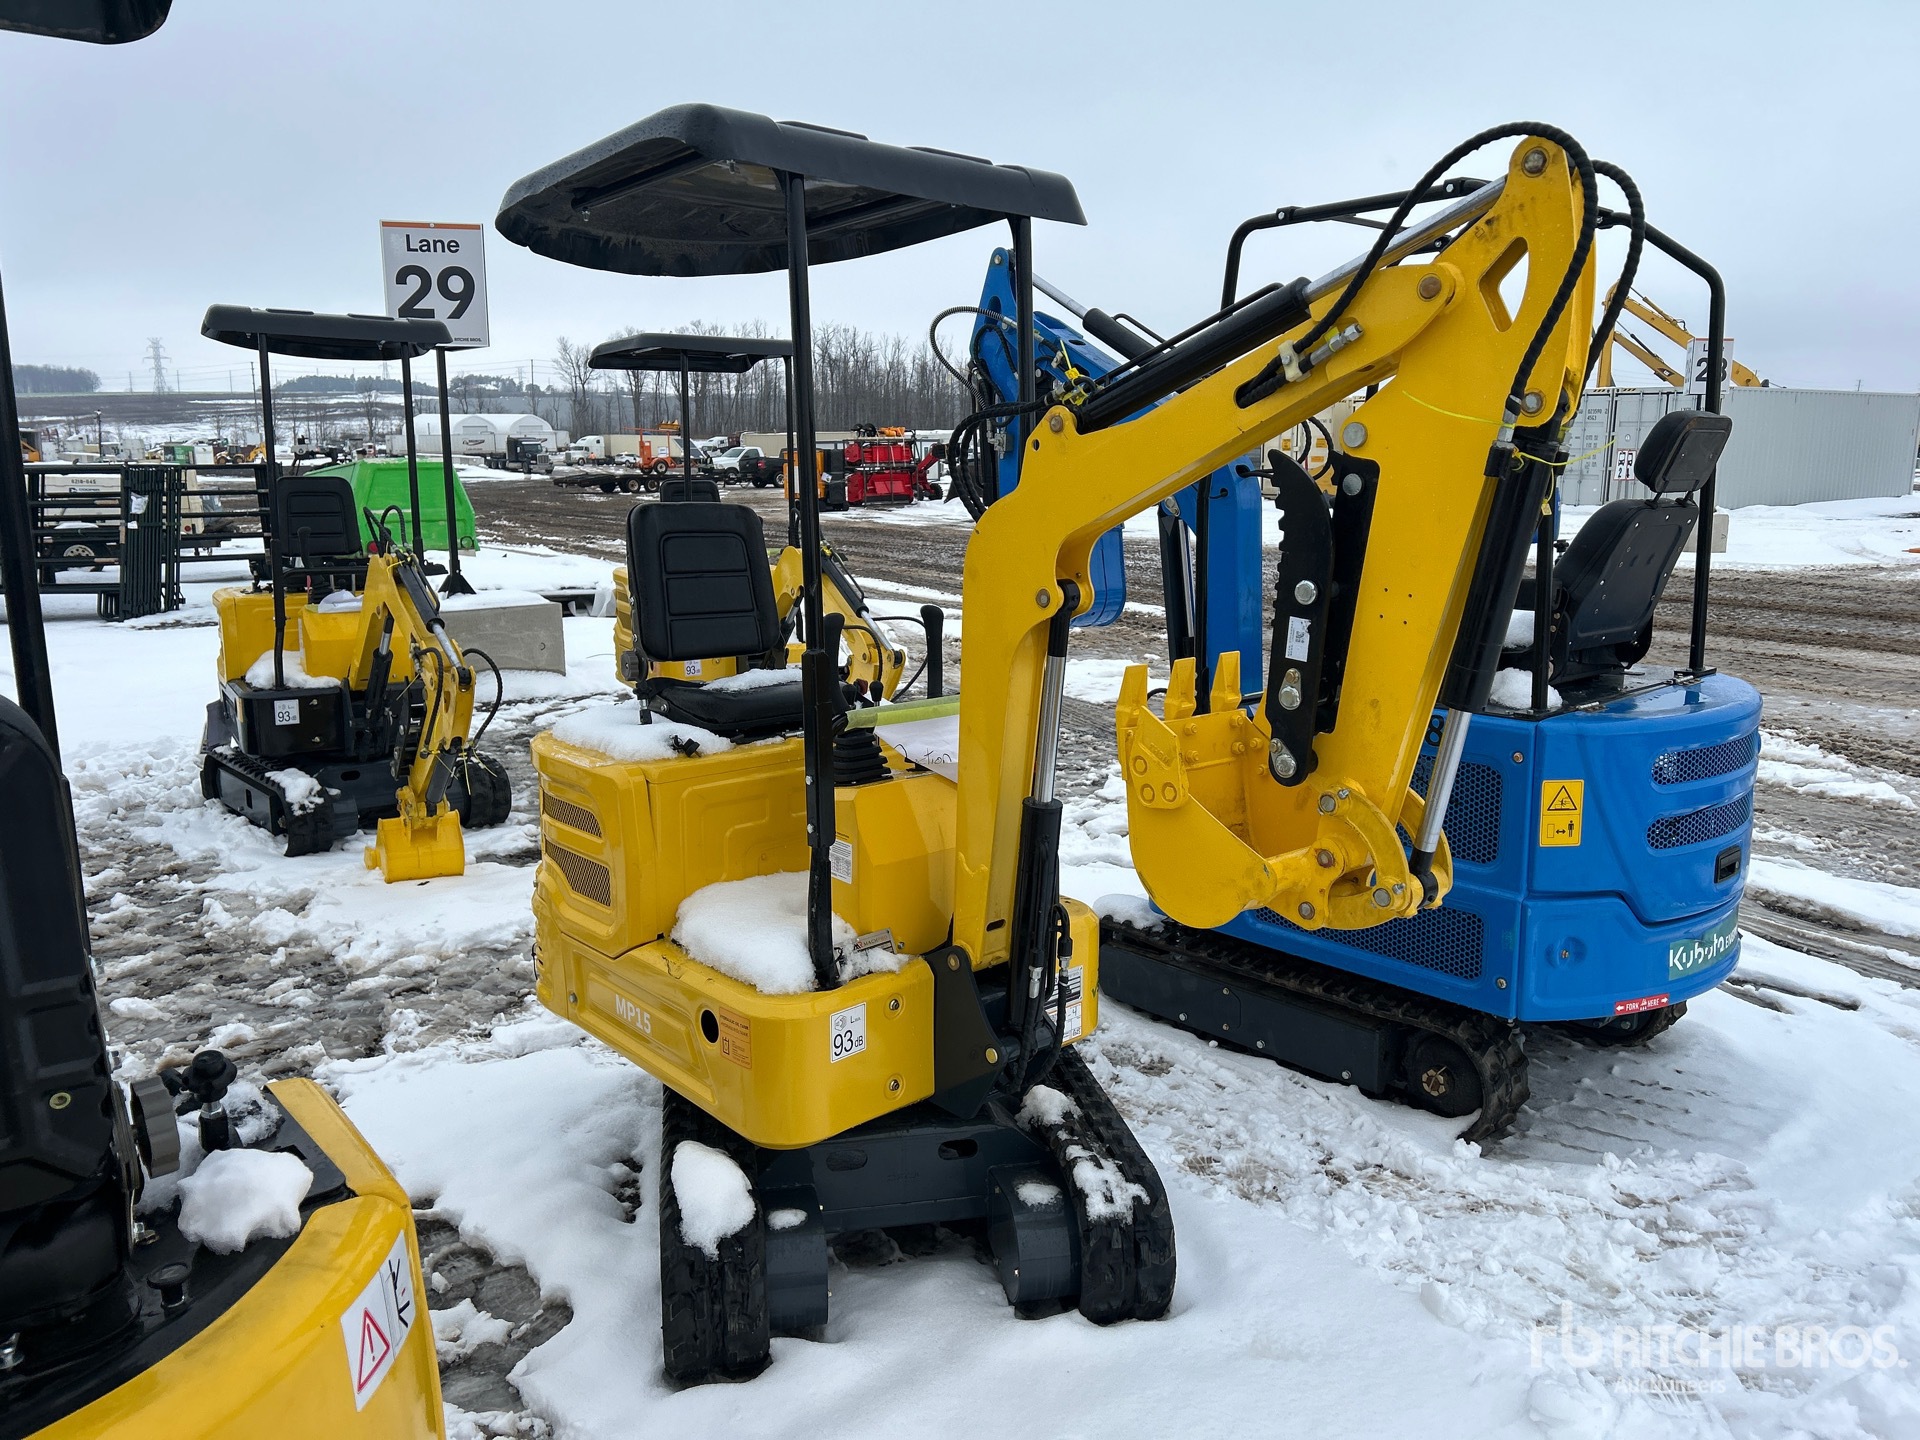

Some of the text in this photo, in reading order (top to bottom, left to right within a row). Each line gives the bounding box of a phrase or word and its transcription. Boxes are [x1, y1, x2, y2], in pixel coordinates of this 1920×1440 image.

[405, 233, 460, 253] Lane
[395, 264, 476, 319] 29
[686, 665, 696, 675] 93
[277, 710, 291, 723] 93
[1669, 933, 1725, 971] Kubota
[615, 993, 651, 1034] MP15
[1625, 998, 1660, 1012] FORK HERE
[833, 1029, 864, 1057] 93 dB
